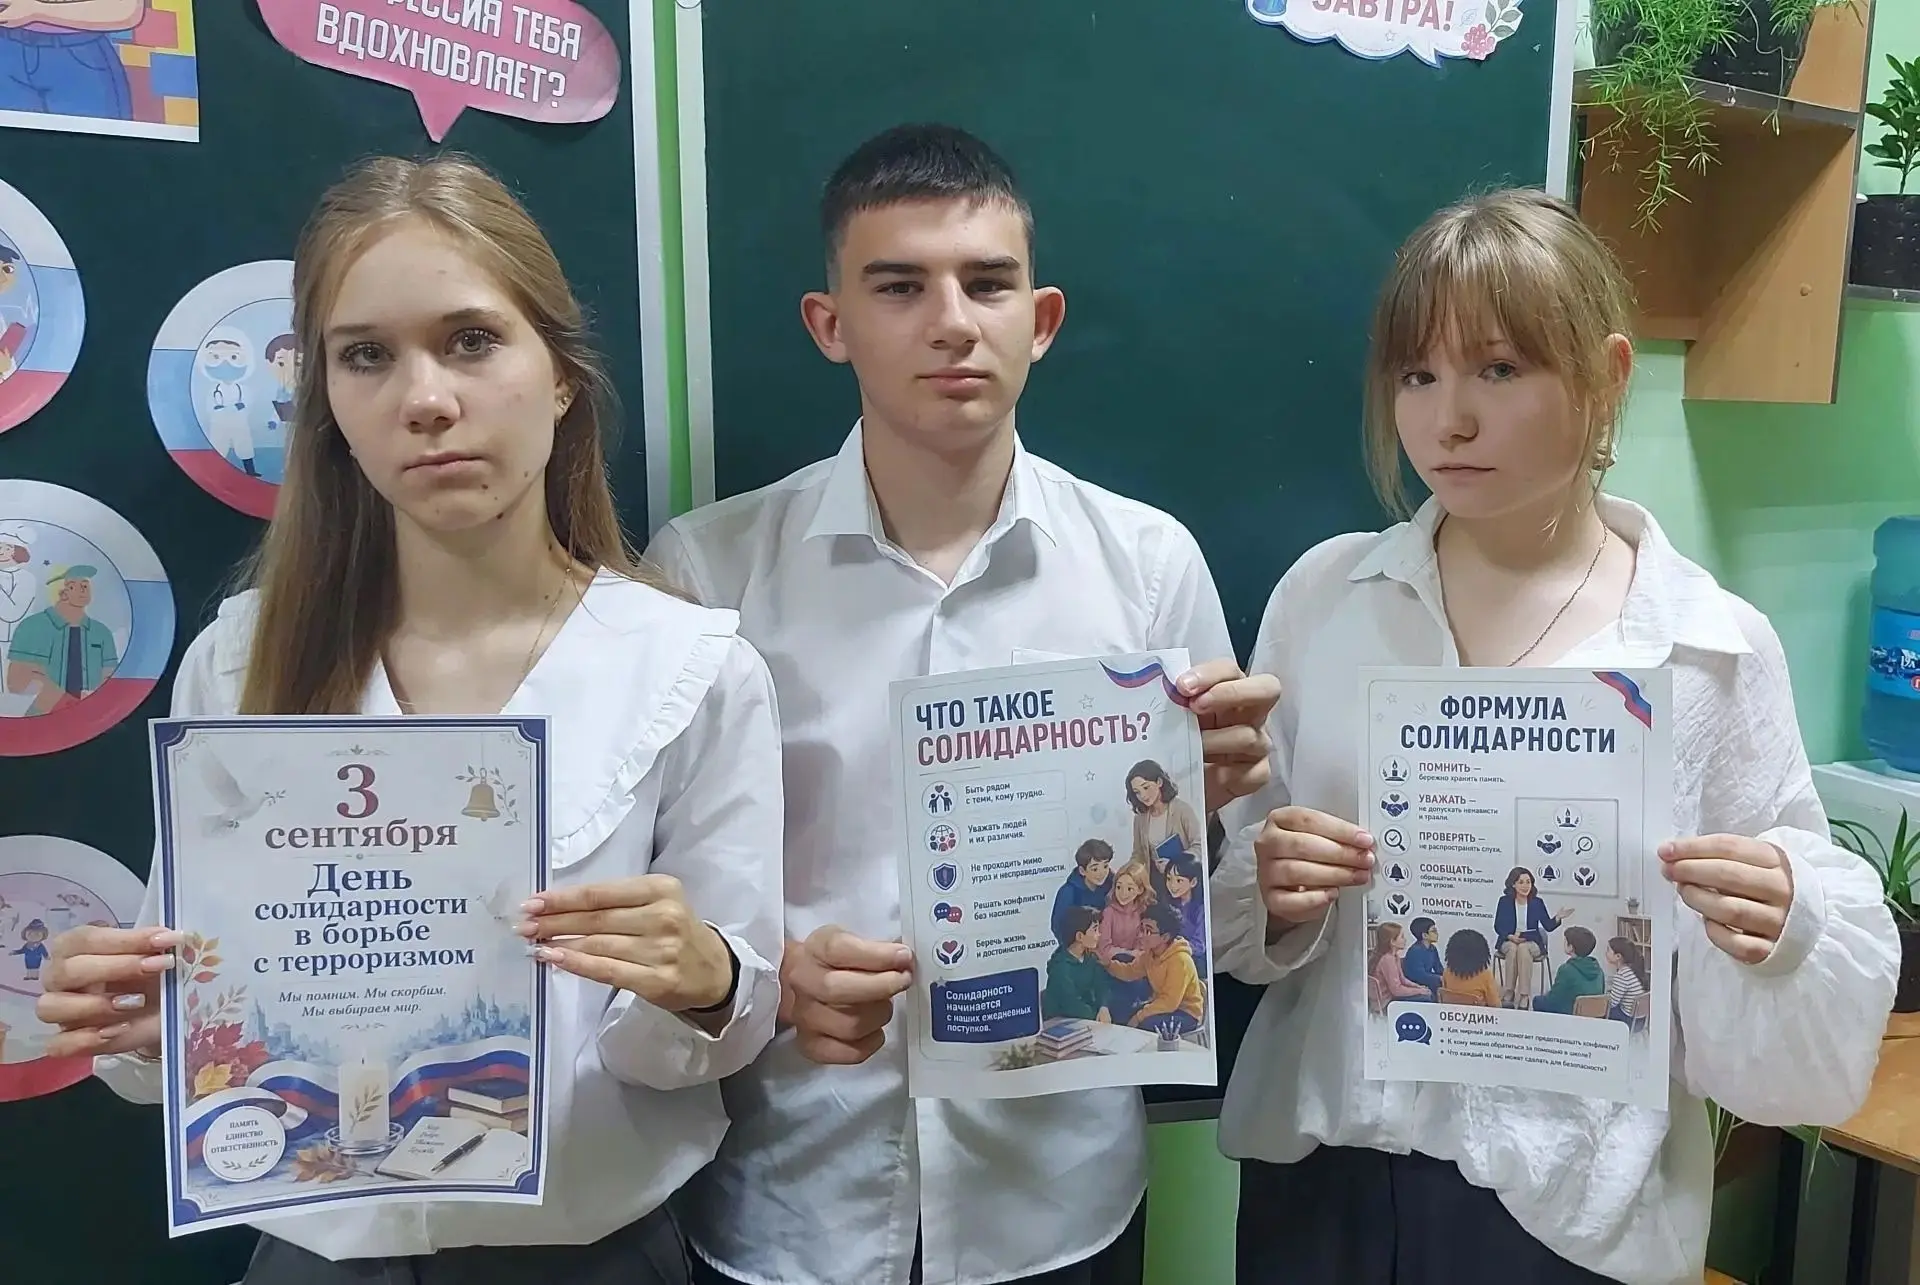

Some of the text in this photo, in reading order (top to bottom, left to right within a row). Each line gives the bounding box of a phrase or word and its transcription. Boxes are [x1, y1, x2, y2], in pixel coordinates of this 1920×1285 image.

[511, 5, 583, 61] ТЕБЯ
[315, 2, 567, 109] ВДОХНОВЛЯЕТ?
[916, 690, 1055, 731] ЧТО ТАКОЕ
[1440, 695, 1567, 720] ФОРМУЛА
[917, 711, 1151, 767] СОЛИДАРНОСТЬ?
[1400, 724, 1616, 754] СОЛИДАРНОСТИ
[1419, 762, 1471, 773] ПОМНИТЬ
[336, 763, 380, 819] 3
[965, 783, 1011, 795] Быть рядом
[995, 792, 1015, 802] кому
[1016, 788, 1045, 800] трудно.
[1418, 794, 1467, 805] УВАЖАТЬ
[967, 818, 1028, 834] Уважать людей
[264, 818, 458, 854] сентября
[975, 836, 985, 844] их
[987, 831, 1025, 844] различия.
[1419, 831, 1476, 843] ПРОВЕРЯТЬ
[970, 856, 1043, 873] Не проходить мимо
[1419, 863, 1473, 875] СООБЩАТЬ
[306, 862, 414, 898] День
[971, 874, 992, 885] угроз
[993, 873, 999, 881] и
[254, 896, 469, 922] солидарности
[973, 893, 1046, 910] Решать конфликты
[1421, 897, 1473, 909] ПОМОГАТЬ
[974, 908, 1021, 921] без насилия.
[294, 920, 431, 949] в борьбе
[975, 933, 1027, 949] Беречь жизнь
[976, 951, 981, 959] и
[982, 943, 1026, 958] достоинство
[253, 947, 475, 976] с терроризмом
[278, 984, 447, 1003] Мы помним. Мы скорбим.
[945, 985, 1014, 1001] Солидарность
[301, 1003, 422, 1017] Мы выбираем мир.
[946, 999, 1001, 1012] начинается
[953, 1014, 981, 1023] наших
[981, 1006, 1032, 1021] ежедневных
[1439, 1011, 1499, 1025] ОБСУДИМ:
[946, 1024, 992, 1035] поступков.
[229, 1119, 259, 1129] ПАМЯТЬ
[225, 1130, 264, 1141] ЕДИНСТВО
[211, 1139, 279, 1154] ОТВЕТСТВЕННОСТЬ
